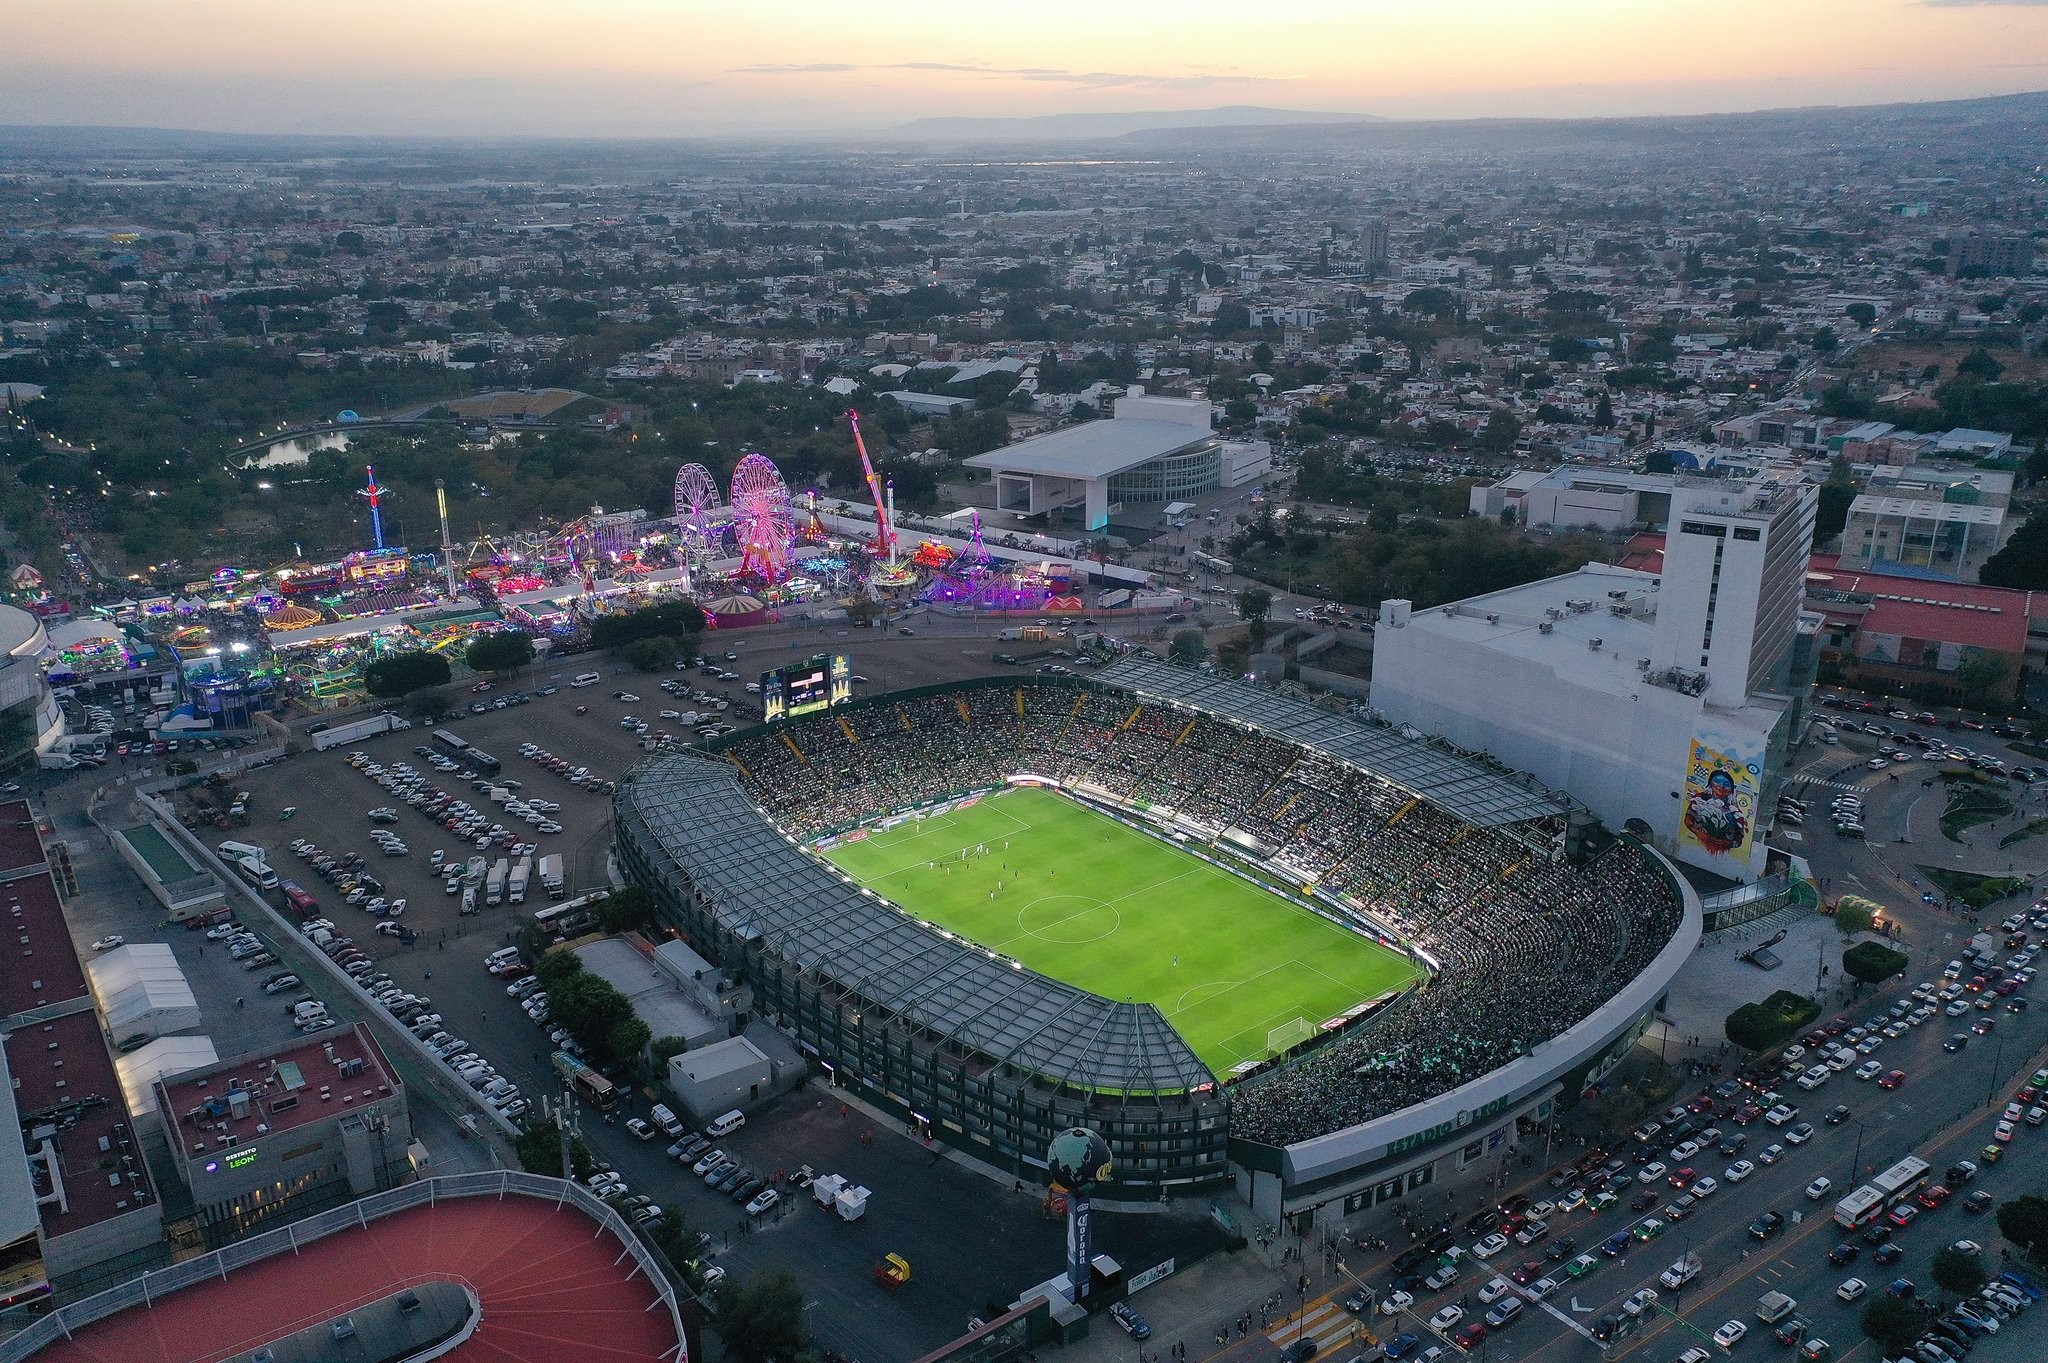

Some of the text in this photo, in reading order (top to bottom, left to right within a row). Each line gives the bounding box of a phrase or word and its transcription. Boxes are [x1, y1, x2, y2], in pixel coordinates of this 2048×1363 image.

[225, 1147, 257, 1162] DISTRITO
[1387, 1121, 1453, 1156] ESTADIO
[1077, 1214, 1089, 1265] Corona
